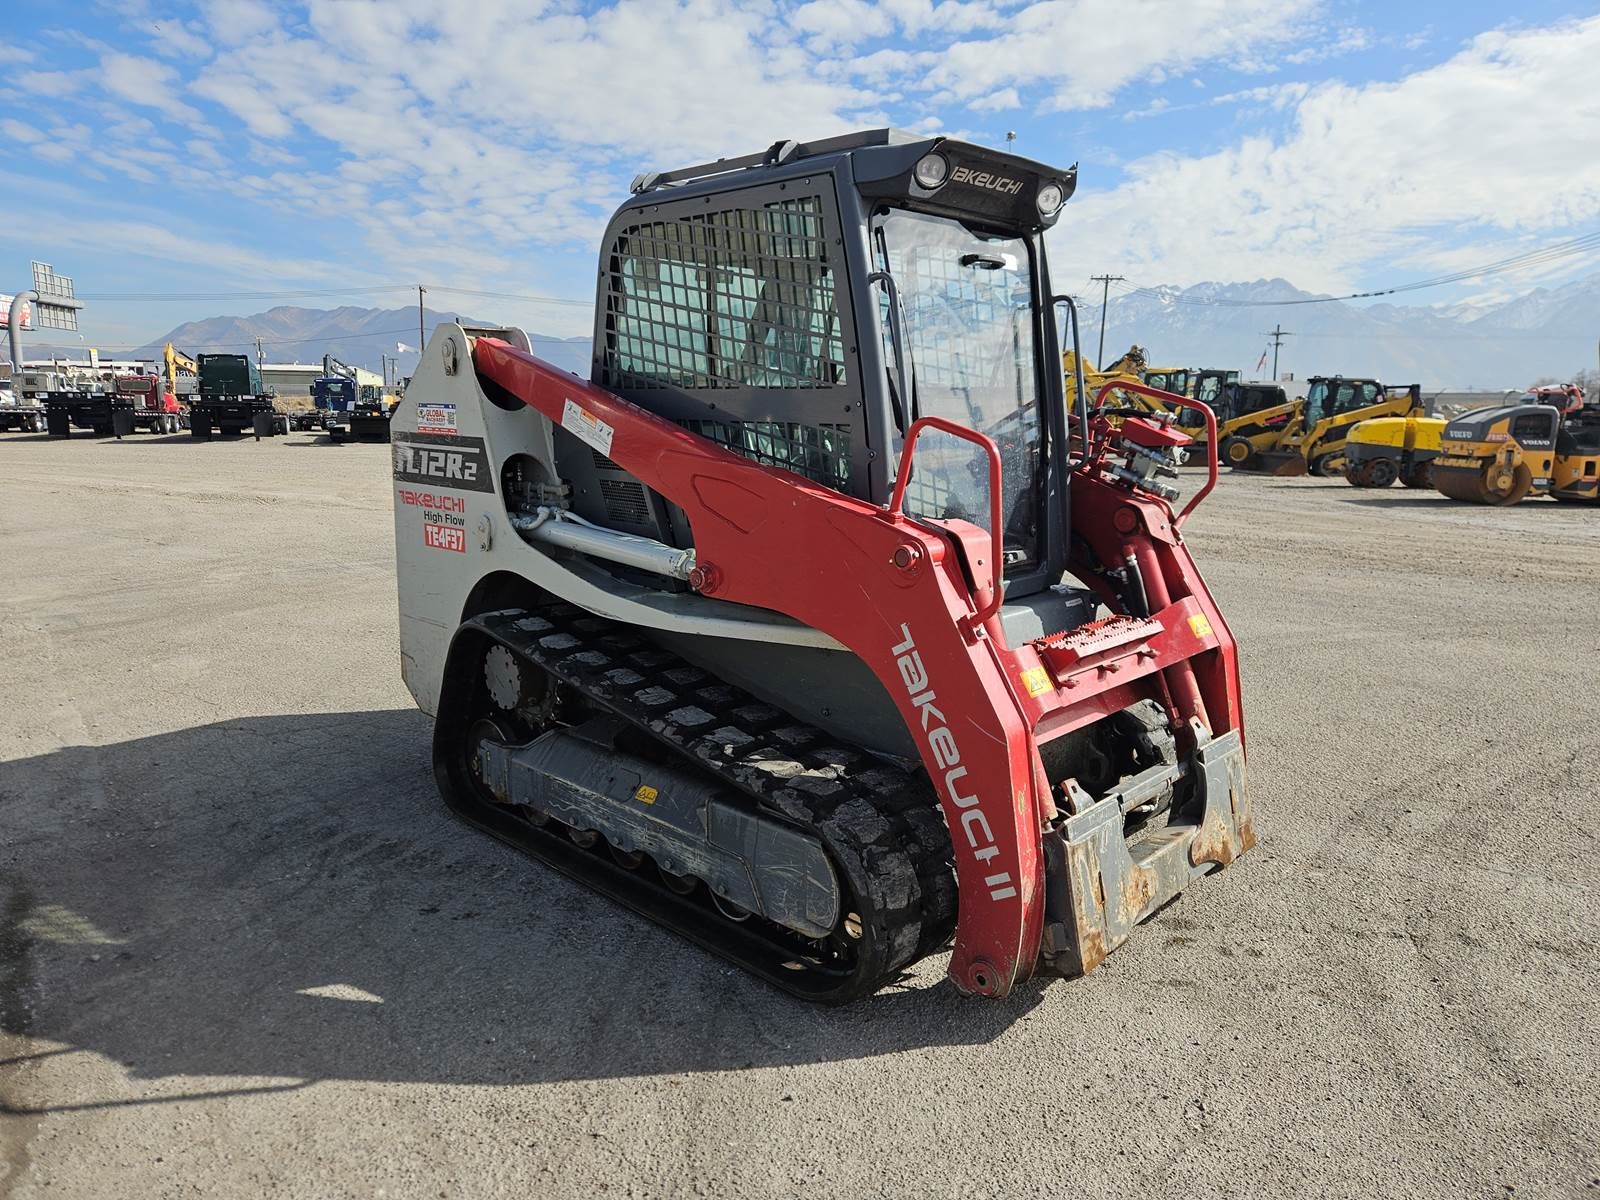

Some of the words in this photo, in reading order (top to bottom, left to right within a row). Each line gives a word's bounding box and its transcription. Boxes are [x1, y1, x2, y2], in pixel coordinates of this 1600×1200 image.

[1450, 430, 1472, 439] VOLVO
[424, 510, 443, 525] High
[445, 513, 465, 526] Flow
[426, 525, 463, 550] TE4F37
